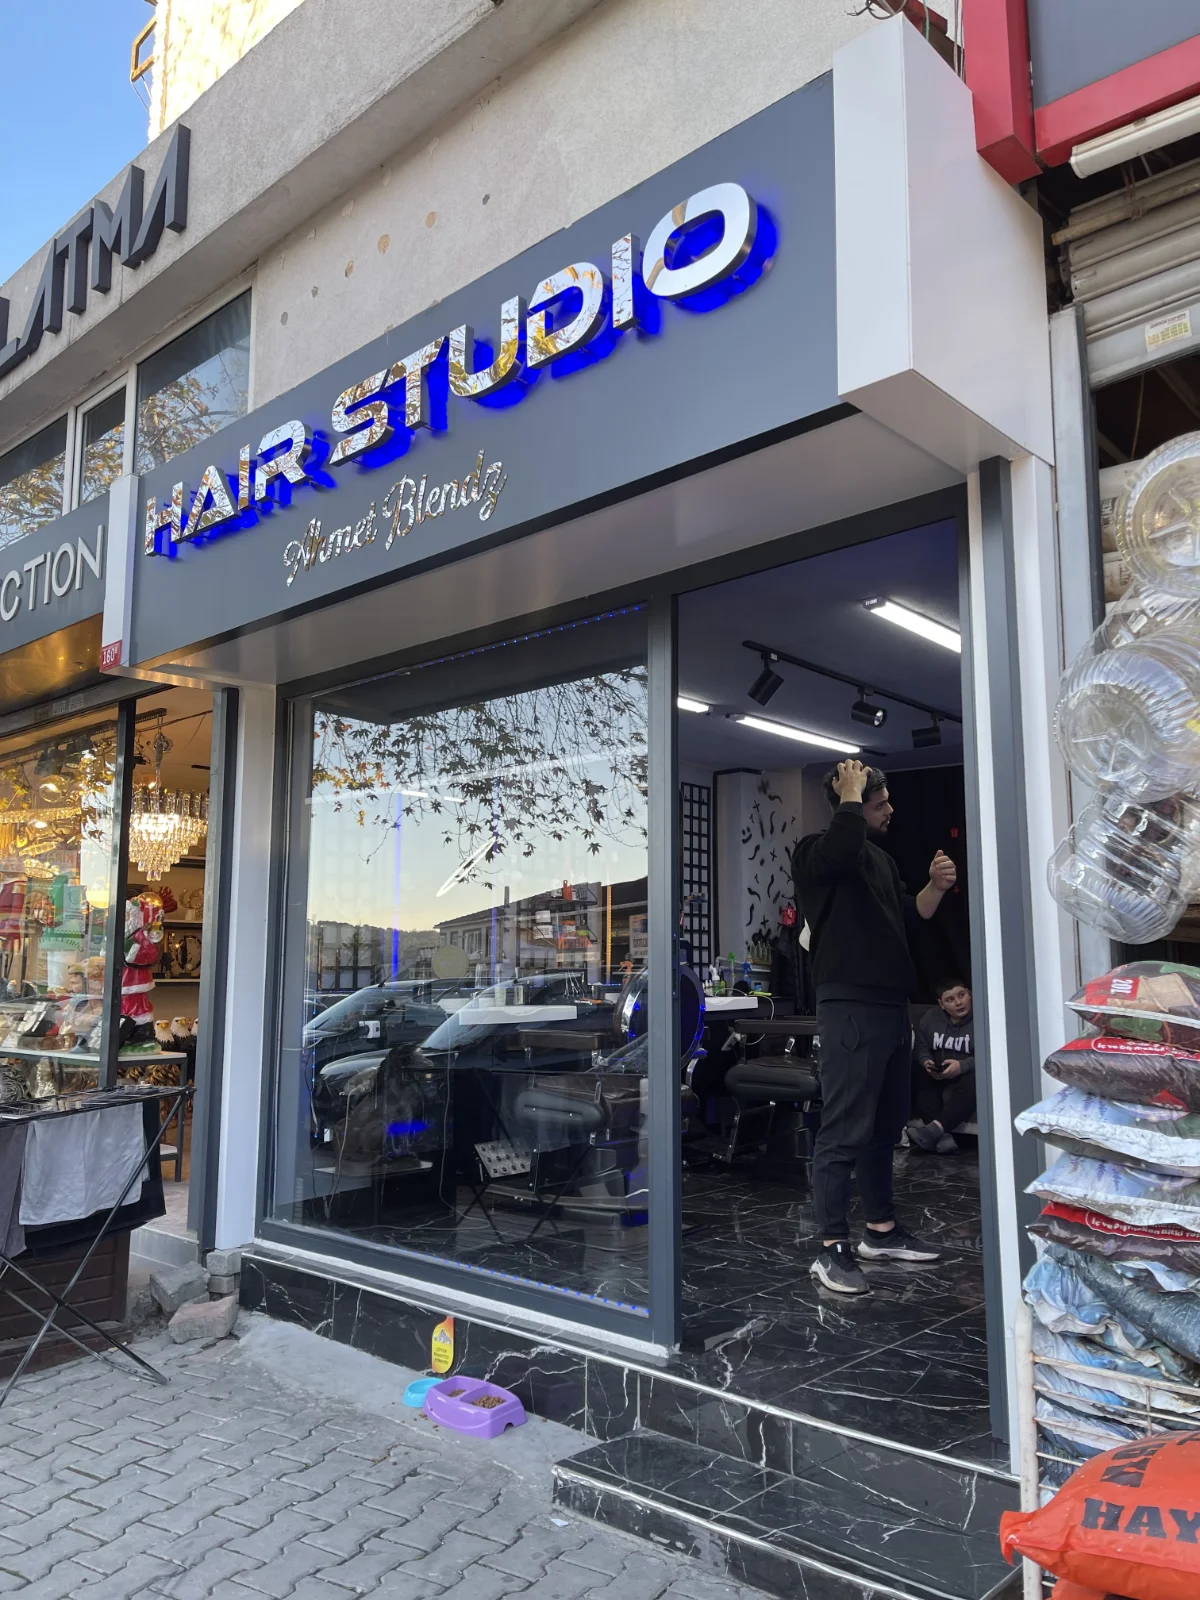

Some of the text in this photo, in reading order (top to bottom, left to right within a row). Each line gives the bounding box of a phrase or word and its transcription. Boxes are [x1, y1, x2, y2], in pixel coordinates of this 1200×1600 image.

[144, 181, 758, 557] HAIR STUDIO
[283, 448, 508, 587] Ahmet Blendz
